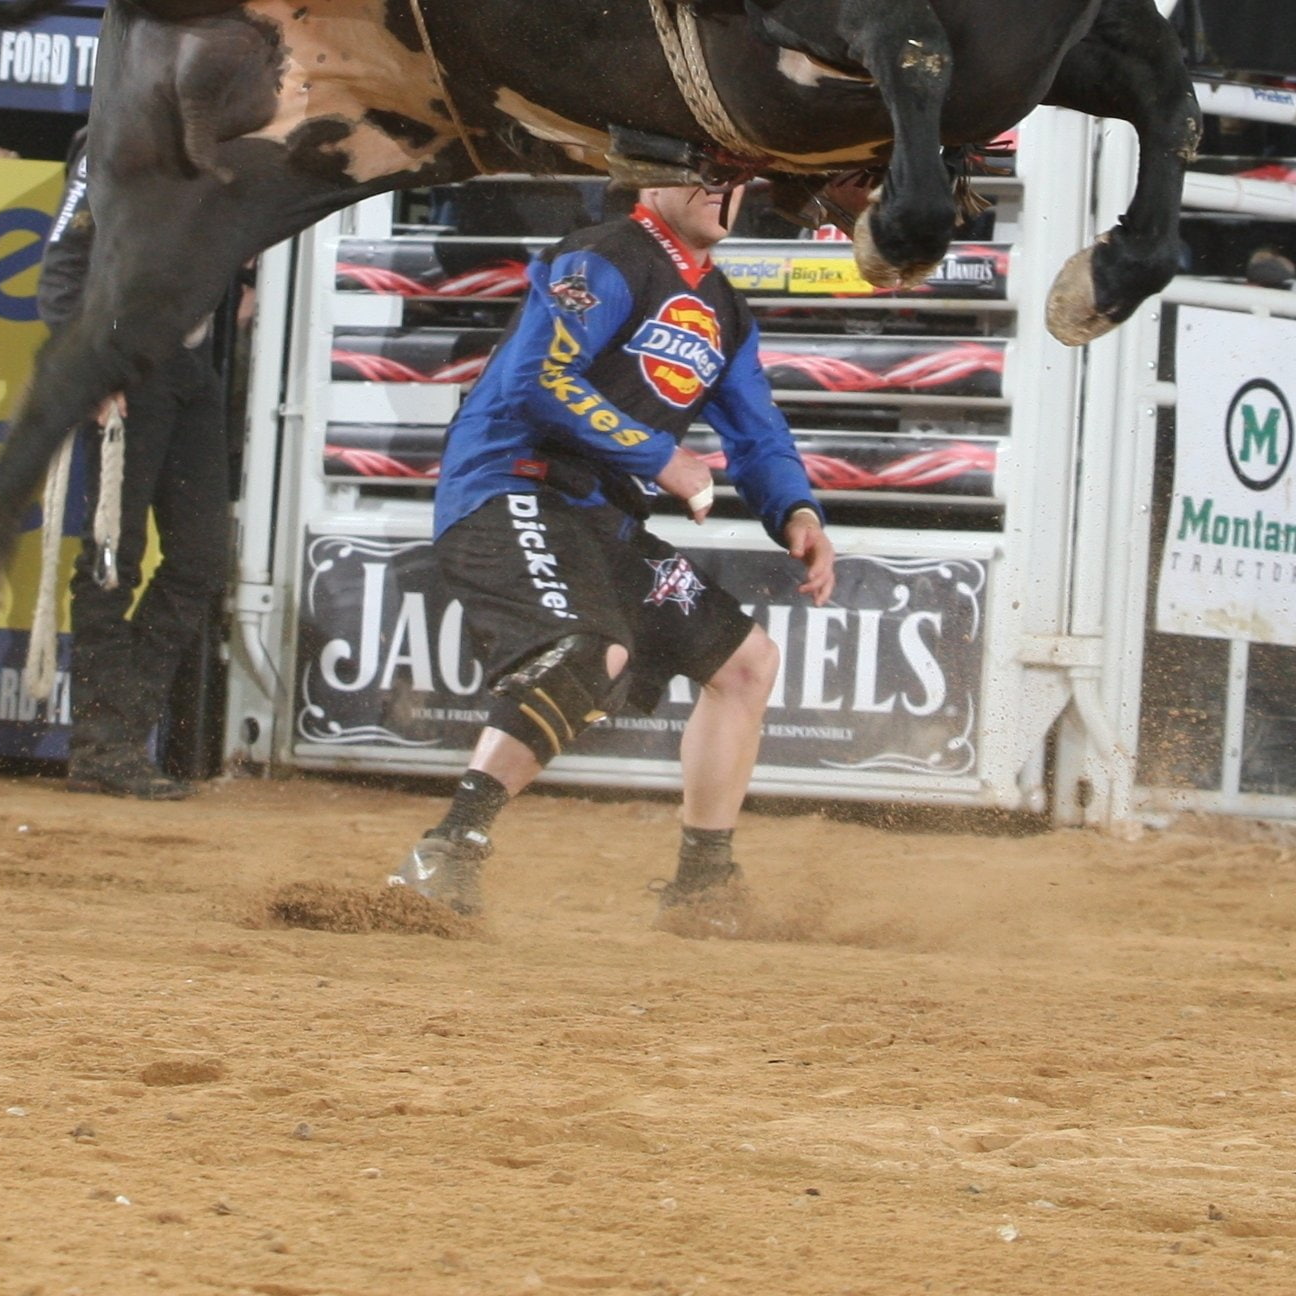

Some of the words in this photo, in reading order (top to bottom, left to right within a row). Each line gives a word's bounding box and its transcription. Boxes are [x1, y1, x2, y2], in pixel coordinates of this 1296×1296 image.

[0, 30, 70, 86] FORD
[1238, 403, 1282, 466] M
[319, 562, 484, 696] JAC
[616, 717, 670, 732] REMIND
[767, 725, 854, 742] RESPONSIBLY
